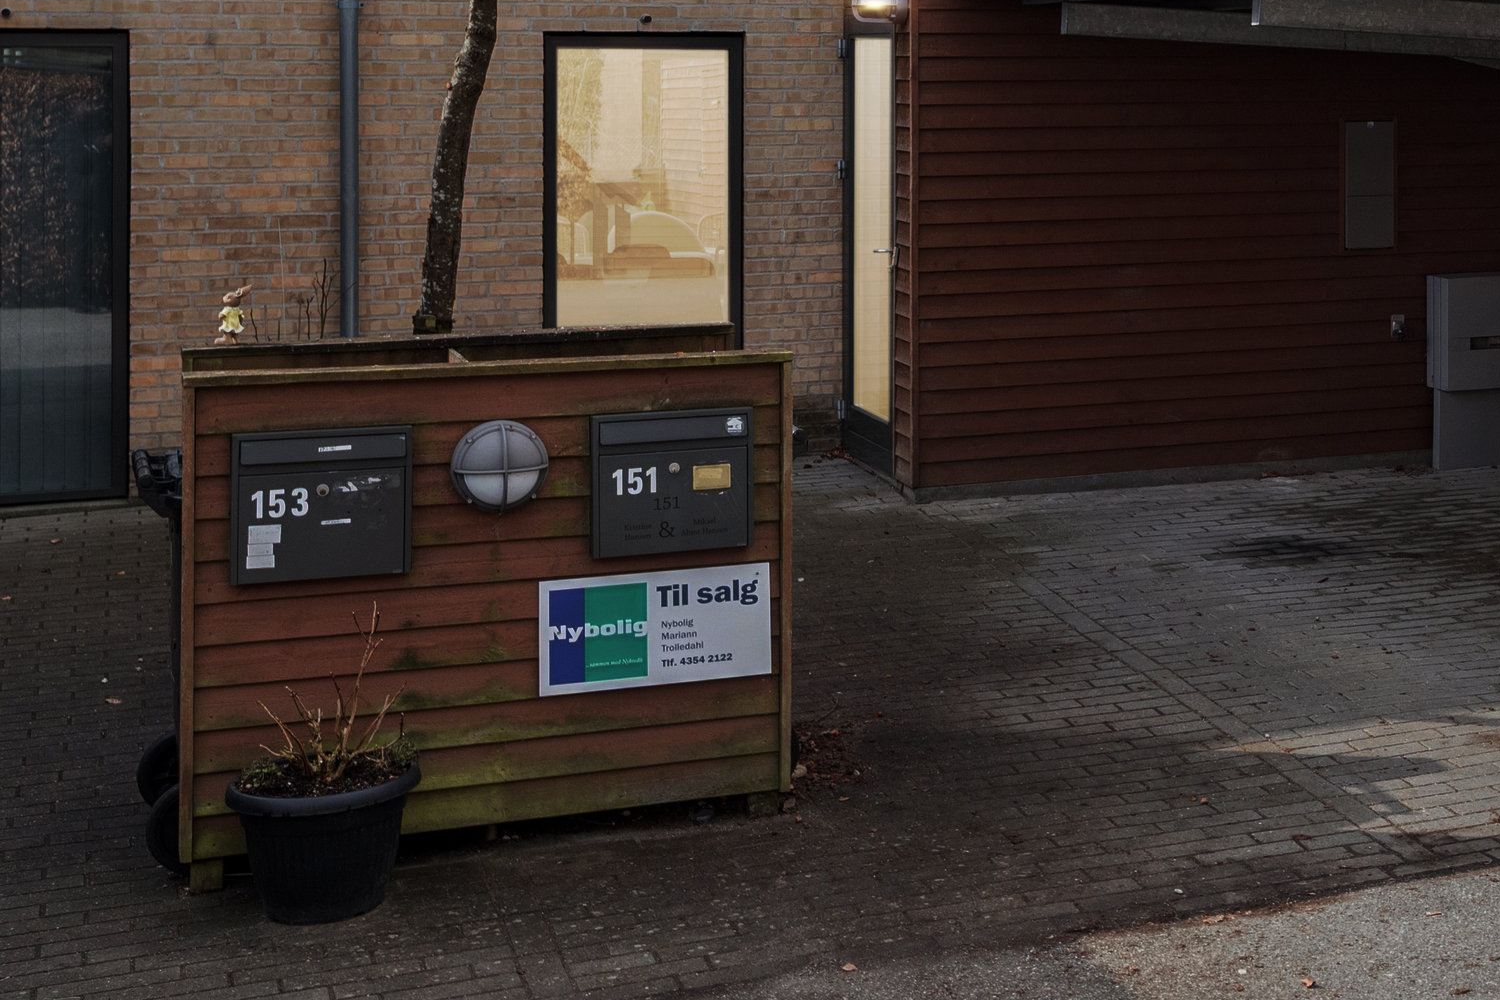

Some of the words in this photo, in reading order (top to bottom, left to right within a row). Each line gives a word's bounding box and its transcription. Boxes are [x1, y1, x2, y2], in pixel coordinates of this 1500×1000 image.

[611, 466, 657, 496] 151
[251, 487, 309, 519] 153
[653, 496, 681, 511] 151
[659, 521, 675, 537] &
[656, 583, 689, 608] Til
[697, 579, 759, 606] salg
[549, 618, 648, 643] Nybolig
[661, 618, 694, 629] Nybolig
[661, 630, 698, 641] Mariann
[661, 641, 704, 653] Trolledahl
[661, 658, 677, 667] Tlf.
[680, 655, 705, 666] 4354
[707, 652, 733, 663] 2122
